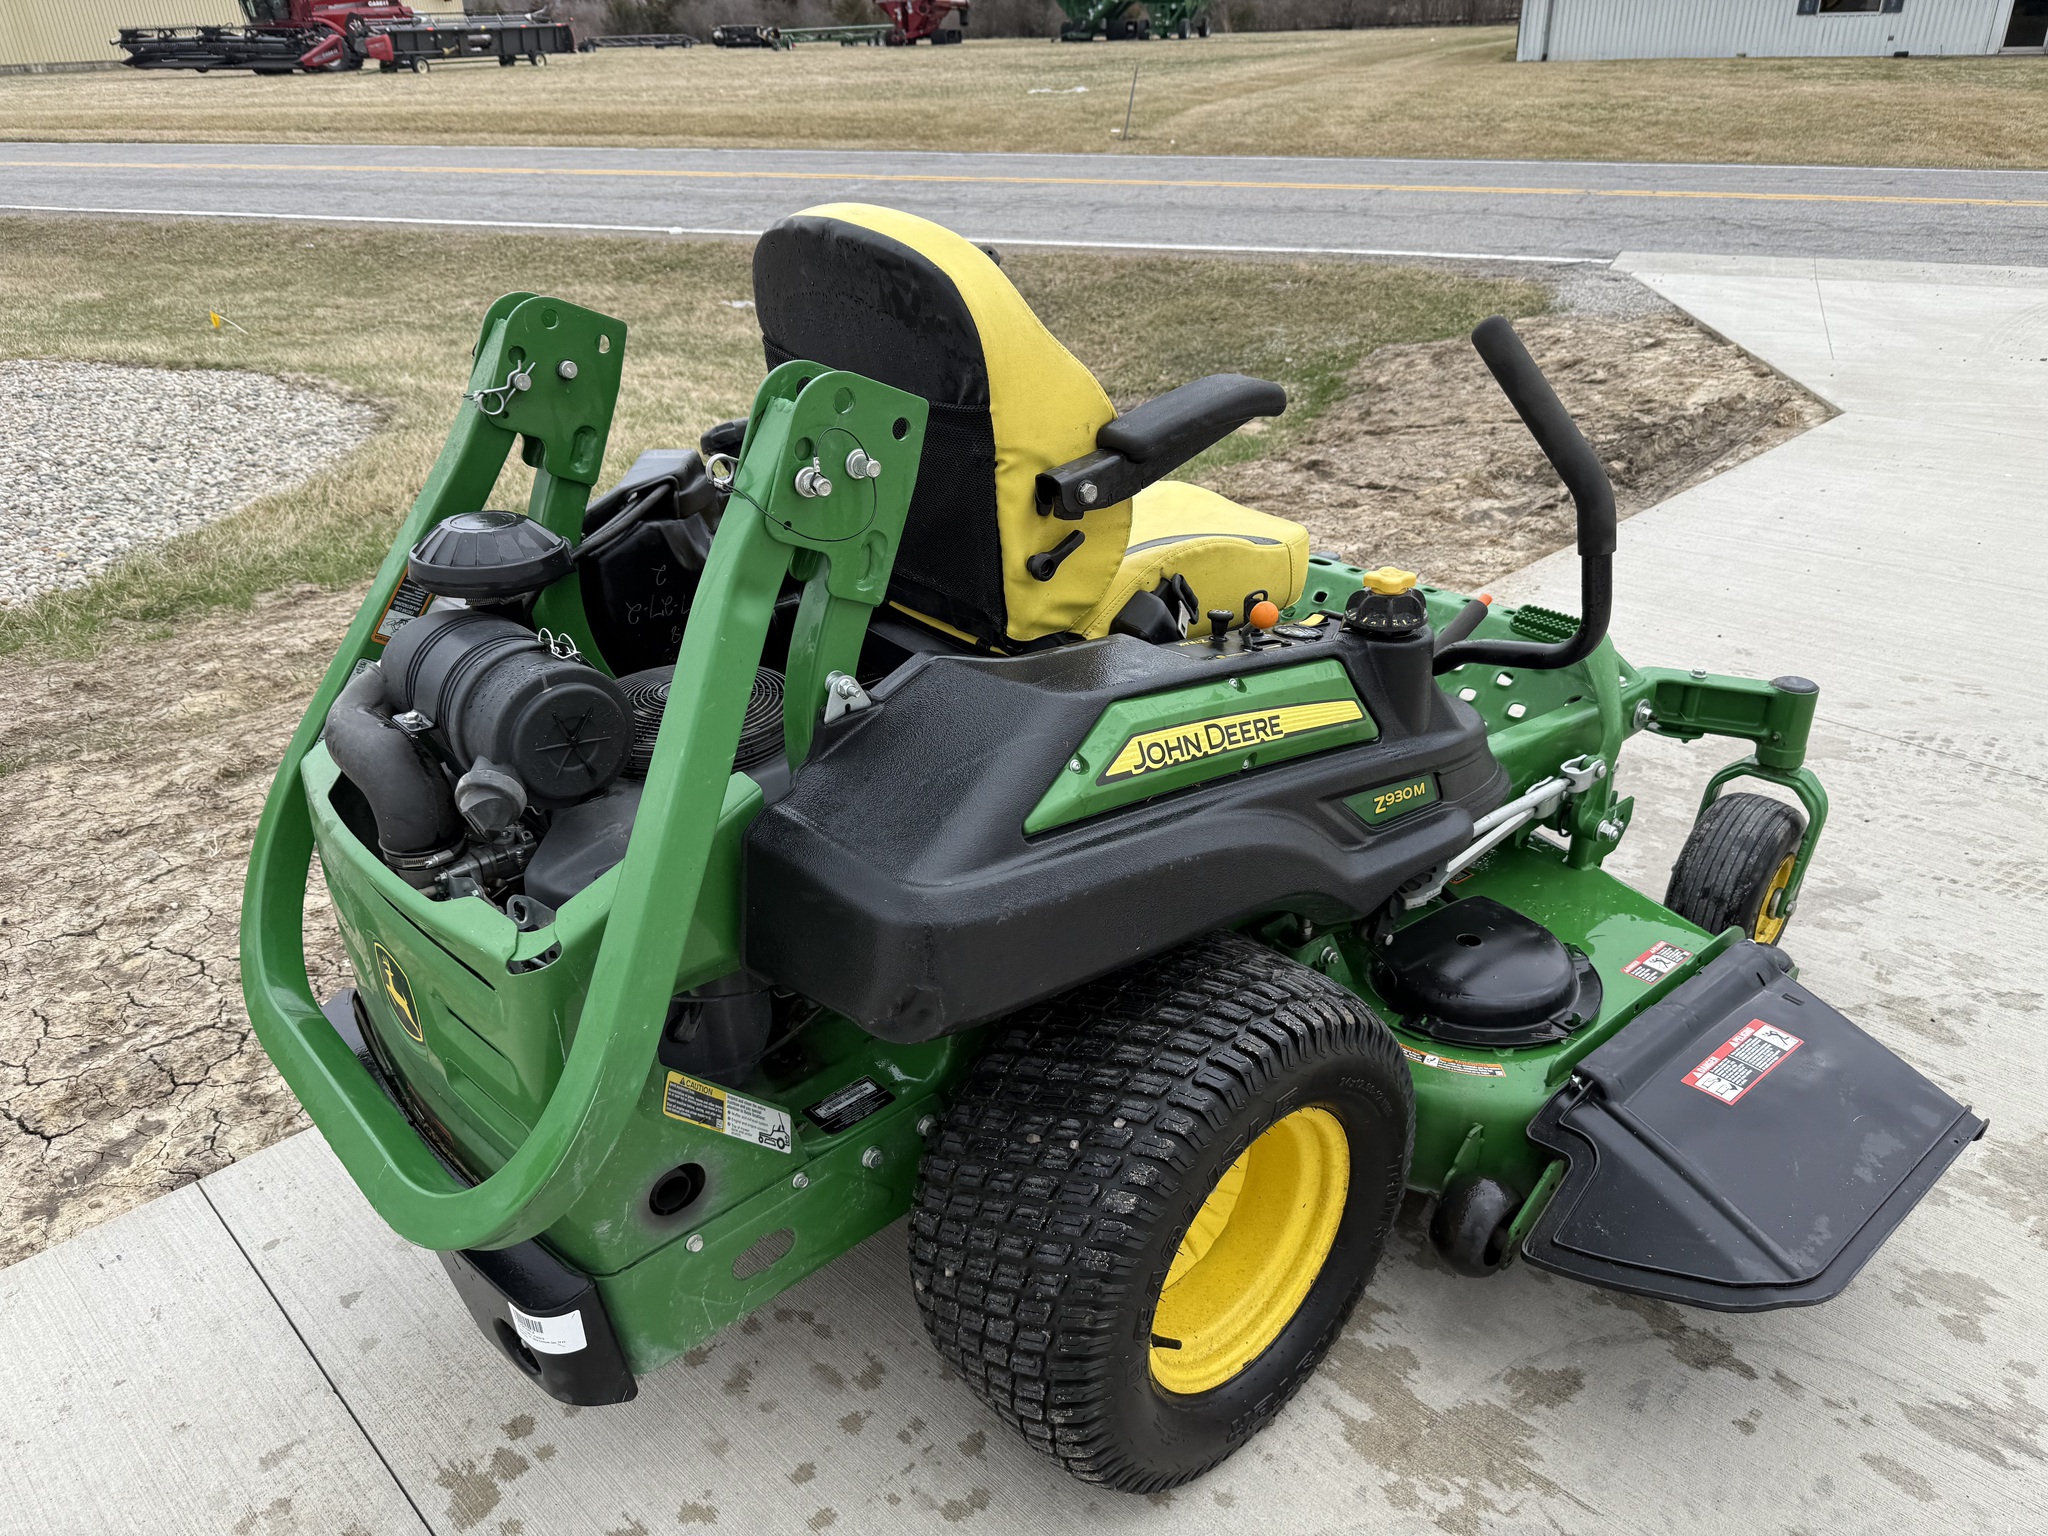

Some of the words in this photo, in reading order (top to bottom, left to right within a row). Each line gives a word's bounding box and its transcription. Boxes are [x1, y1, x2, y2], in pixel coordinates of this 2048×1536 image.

[1133, 733, 1203, 771] JOHN
[1204, 714, 1284, 750] DEERE
[685, 1079, 714, 1096] CAUTION
